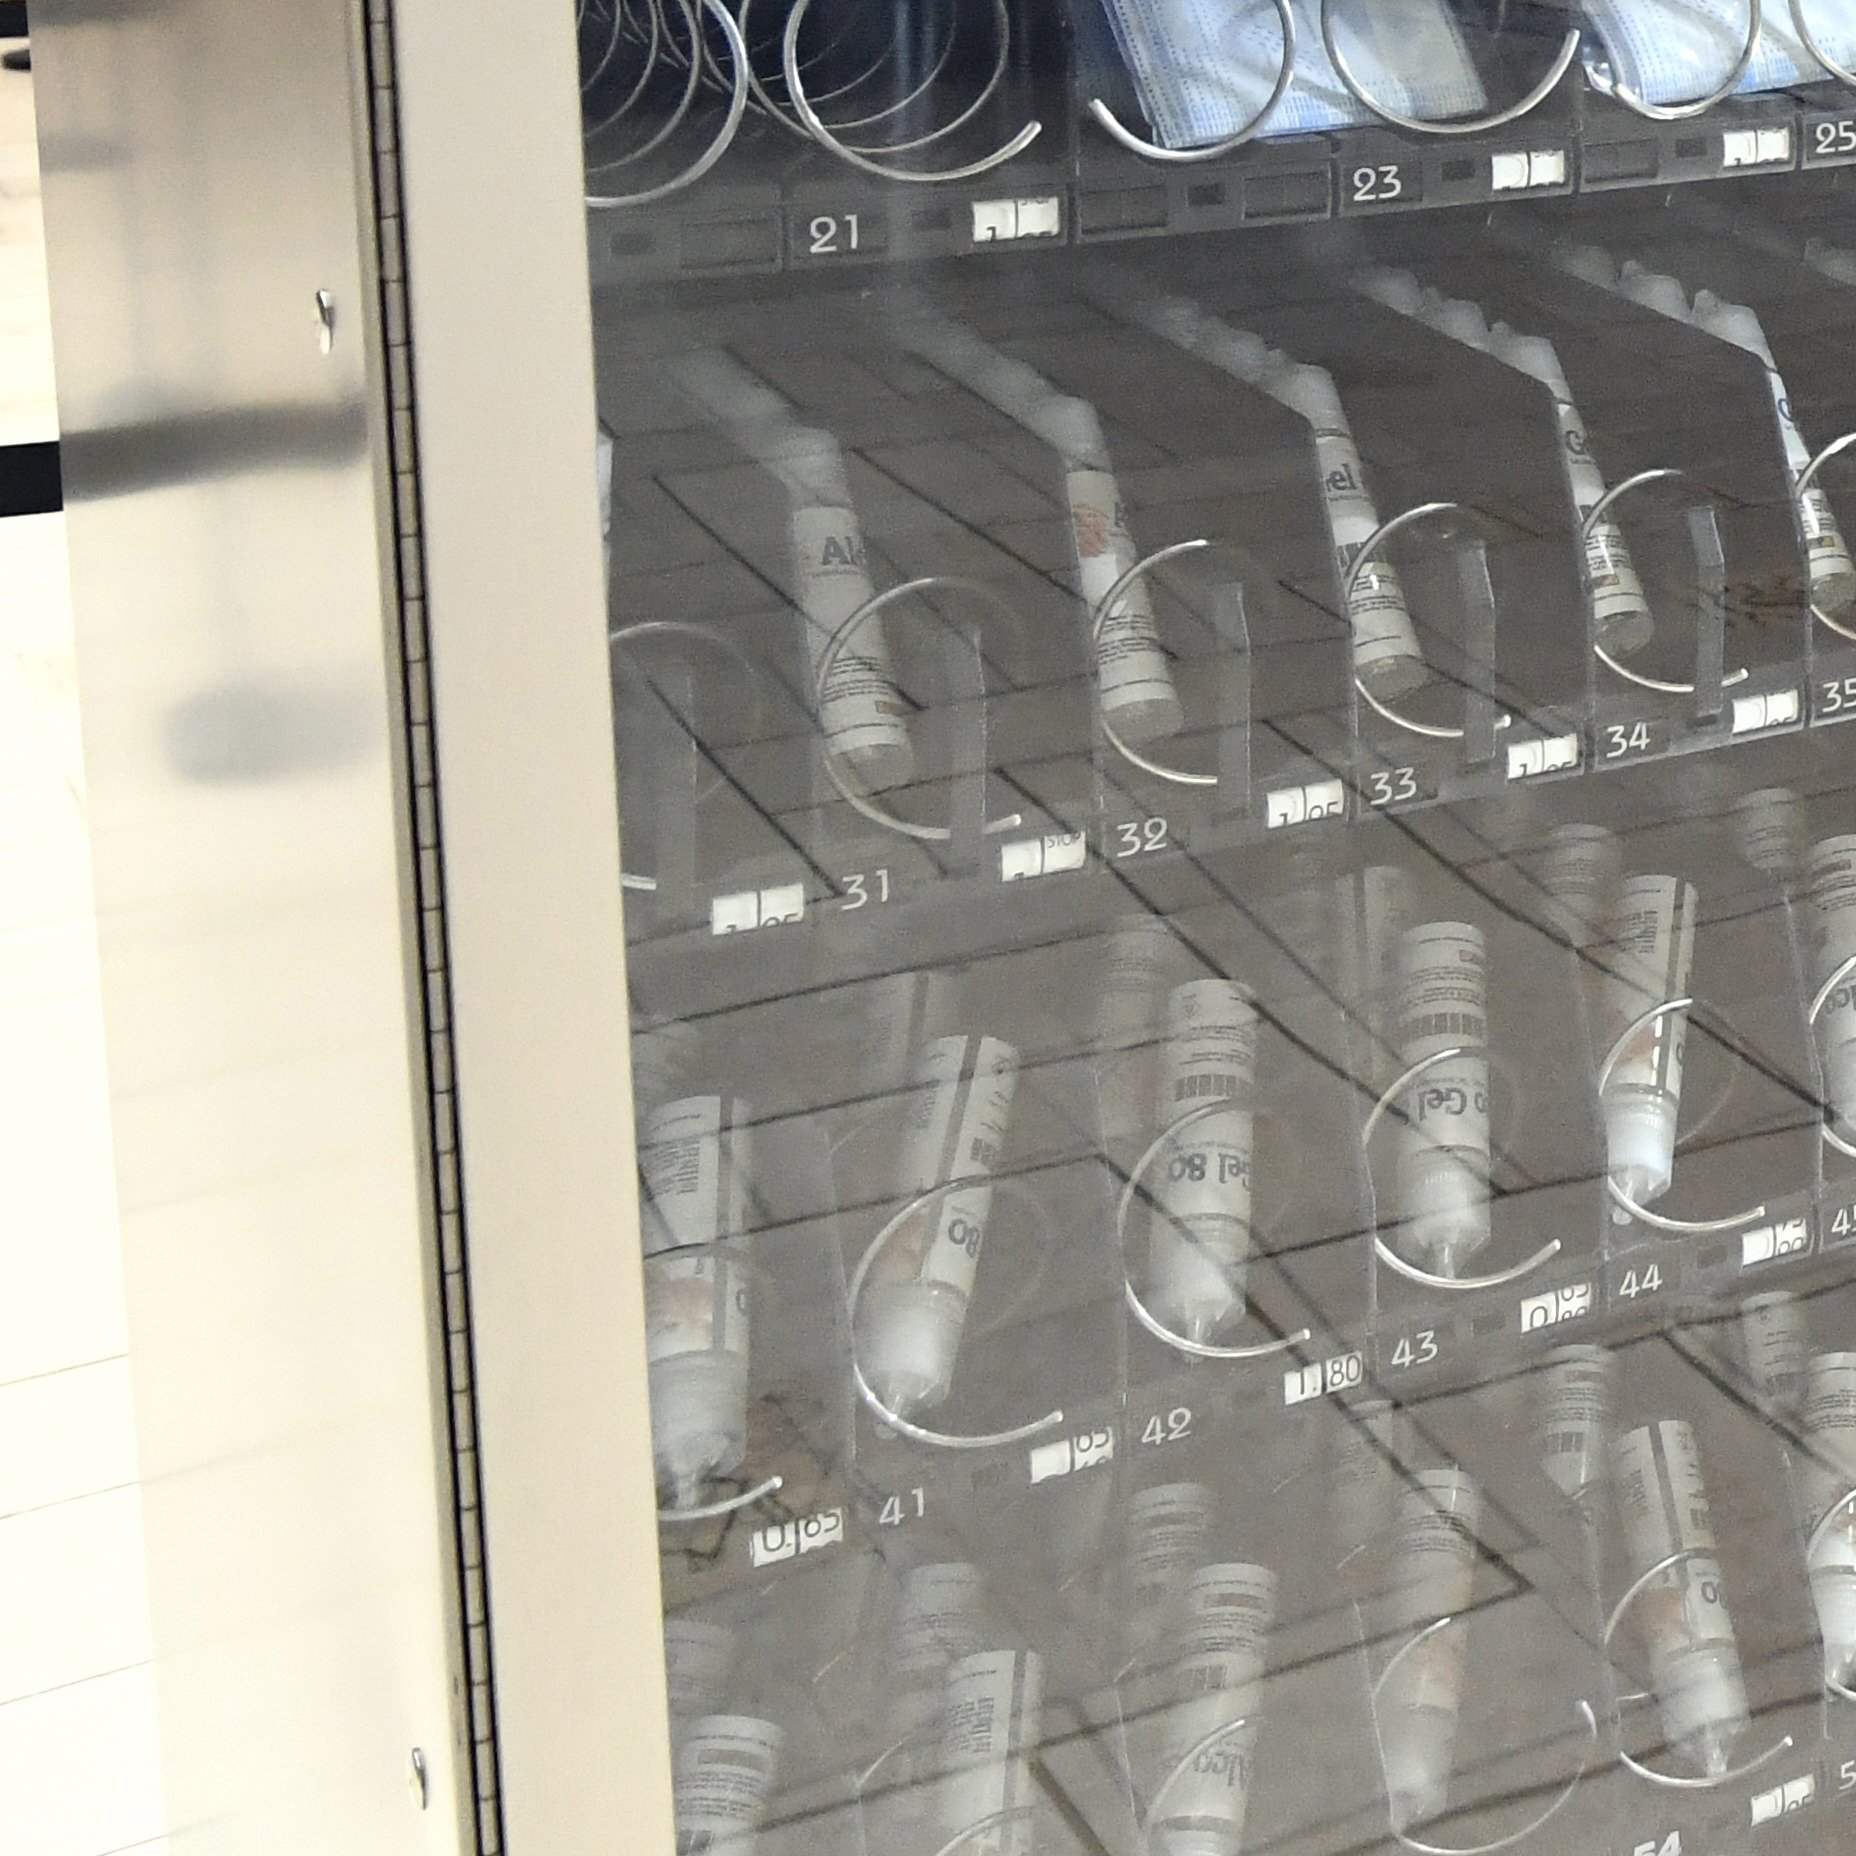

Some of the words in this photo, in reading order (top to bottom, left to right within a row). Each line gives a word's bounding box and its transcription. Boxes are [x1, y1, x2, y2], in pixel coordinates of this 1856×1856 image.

[1353, 165, 1401, 201] 23
[809, 214, 860, 253] 21
[1606, 721, 1651, 759] 34
[1370, 767, 1417, 806] 33
[1116, 817, 1168, 858] 32
[841, 869, 889, 912] 31
[1618, 1264, 1663, 1299] 44
[1391, 1329, 1439, 1369] 43
[1141, 1407, 1192, 1446] 42
[878, 1487, 926, 1527] 41
